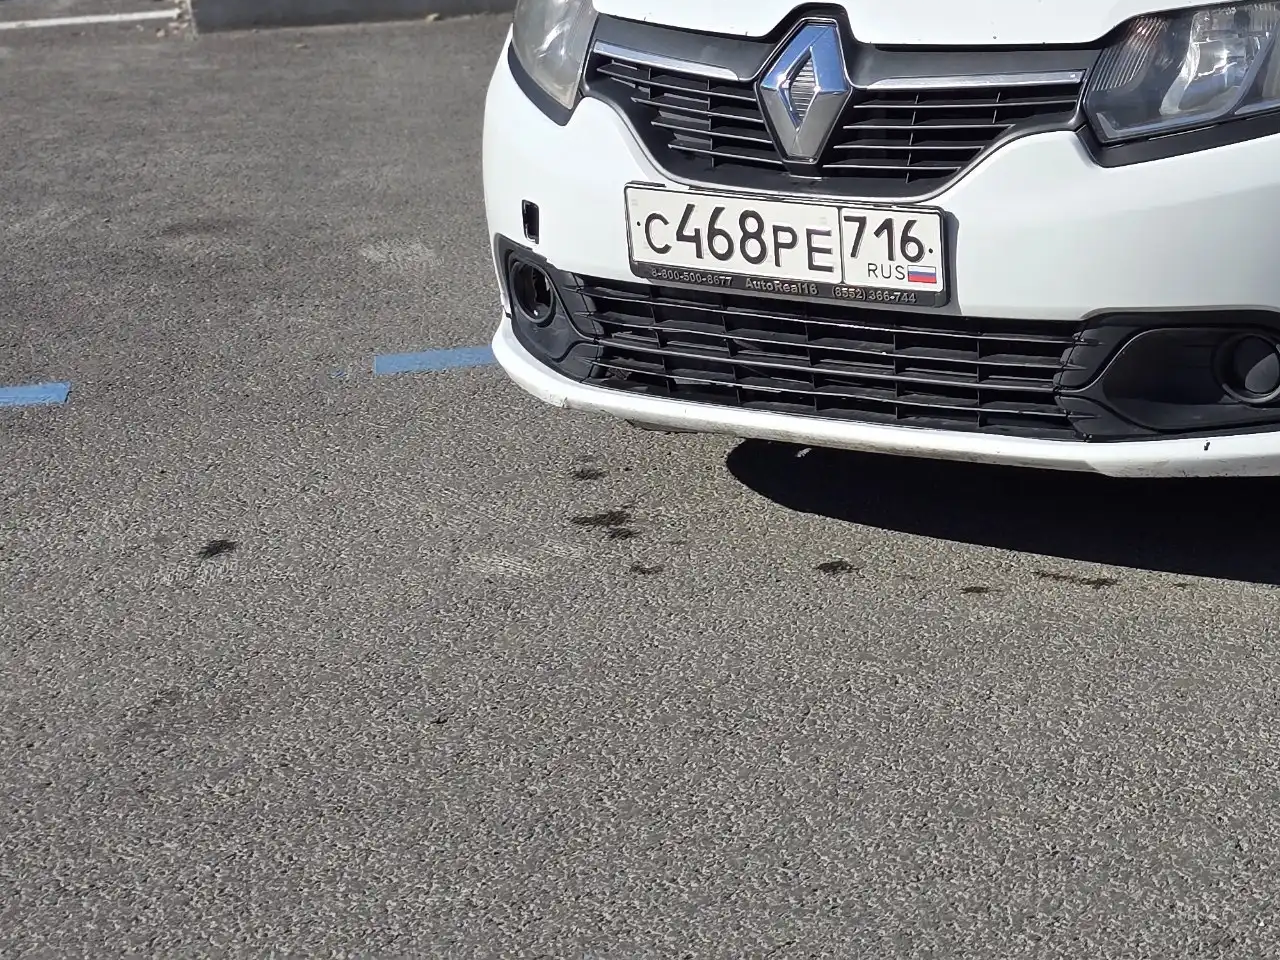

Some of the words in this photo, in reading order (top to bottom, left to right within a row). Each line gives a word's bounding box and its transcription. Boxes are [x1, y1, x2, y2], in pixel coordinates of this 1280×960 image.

[843, 215, 926, 263] 716
[651, 267, 734, 287] 8-800-500-8677
[745, 277, 819, 296] AutoReal16
[831, 286, 867, 301] (8552)
[868, 290, 917, 304] 366-744
[867, 262, 906, 281] RUS
